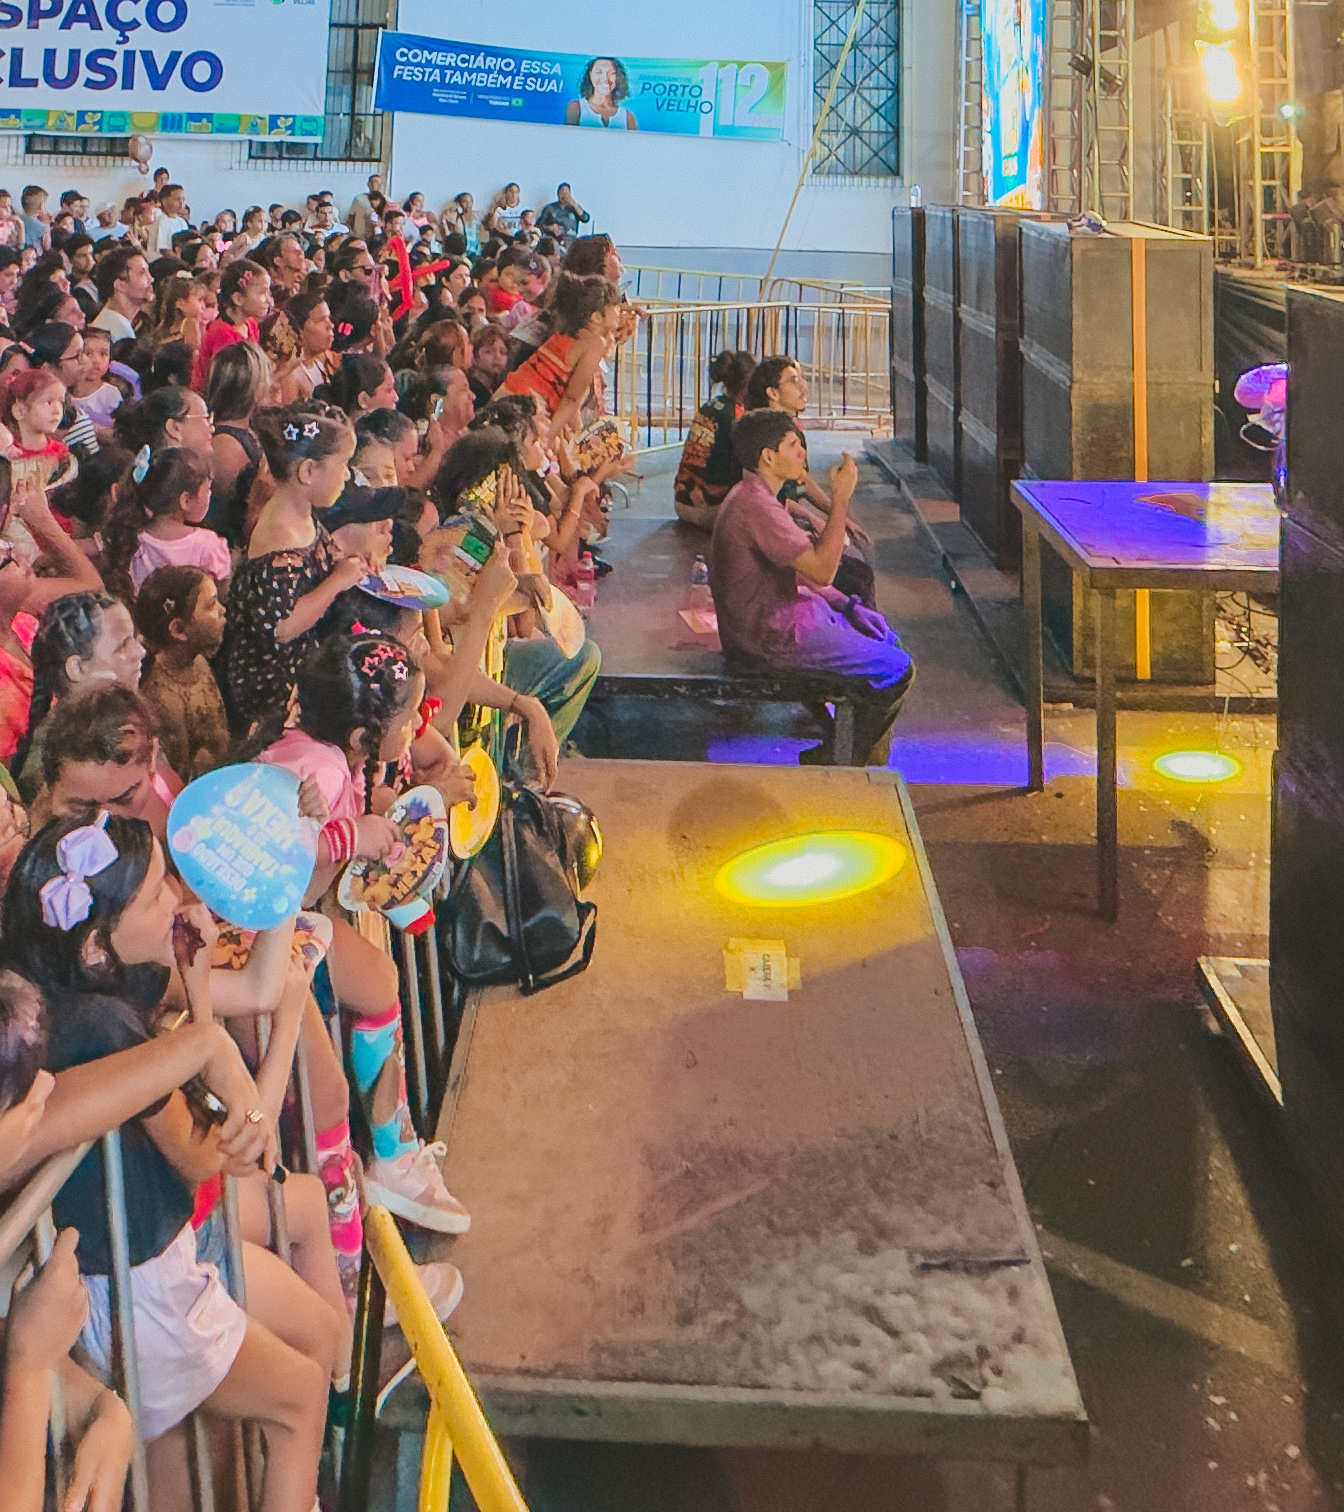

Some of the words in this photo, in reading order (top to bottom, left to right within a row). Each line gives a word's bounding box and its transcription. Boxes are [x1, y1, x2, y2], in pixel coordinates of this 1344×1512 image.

[395, 47, 517, 74] COMERCIÁRIO,
[520, 59, 562, 76] ESSA
[392, 65, 441, 83] FESTA
[444, 69, 513, 90] TAMBÉM
[512, 72, 524, 90] É
[525, 78, 564, 93] SUA!
[640, 82, 703, 98] PORTO
[698, 61, 784, 137] 112
[655, 97, 714, 114] VELHO
